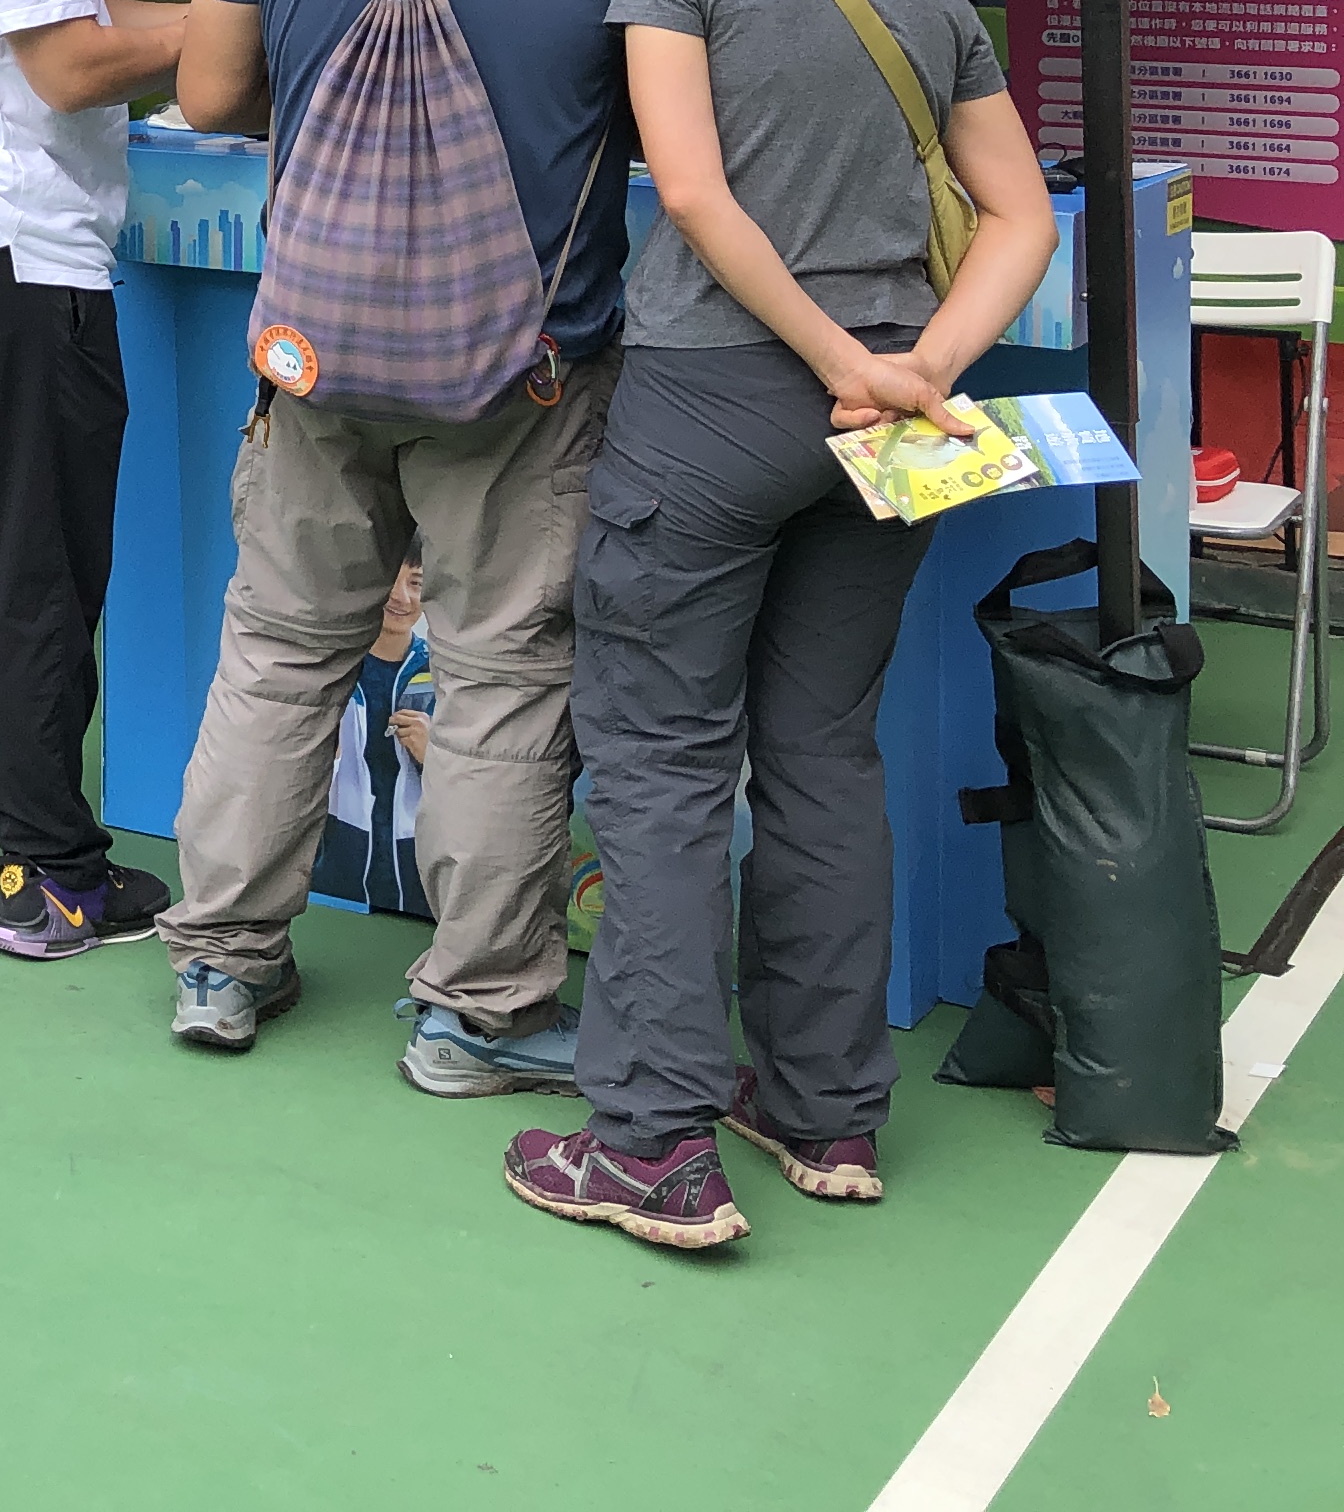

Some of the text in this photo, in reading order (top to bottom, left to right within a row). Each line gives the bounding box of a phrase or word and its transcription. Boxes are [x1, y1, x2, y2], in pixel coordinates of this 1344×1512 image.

[1229, 69, 1257, 80] 3661
[1263, 71, 1293, 82] 1630
[1229, 93, 1257, 104] 3661
[1263, 95, 1292, 106] 1694
[1228, 116, 1256, 128] 3661
[1262, 119, 1292, 130] 1696
[1228, 140, 1256, 151] 3661
[1262, 143, 1291, 154] 1664
[1228, 163, 1291, 178] 3661 1674
